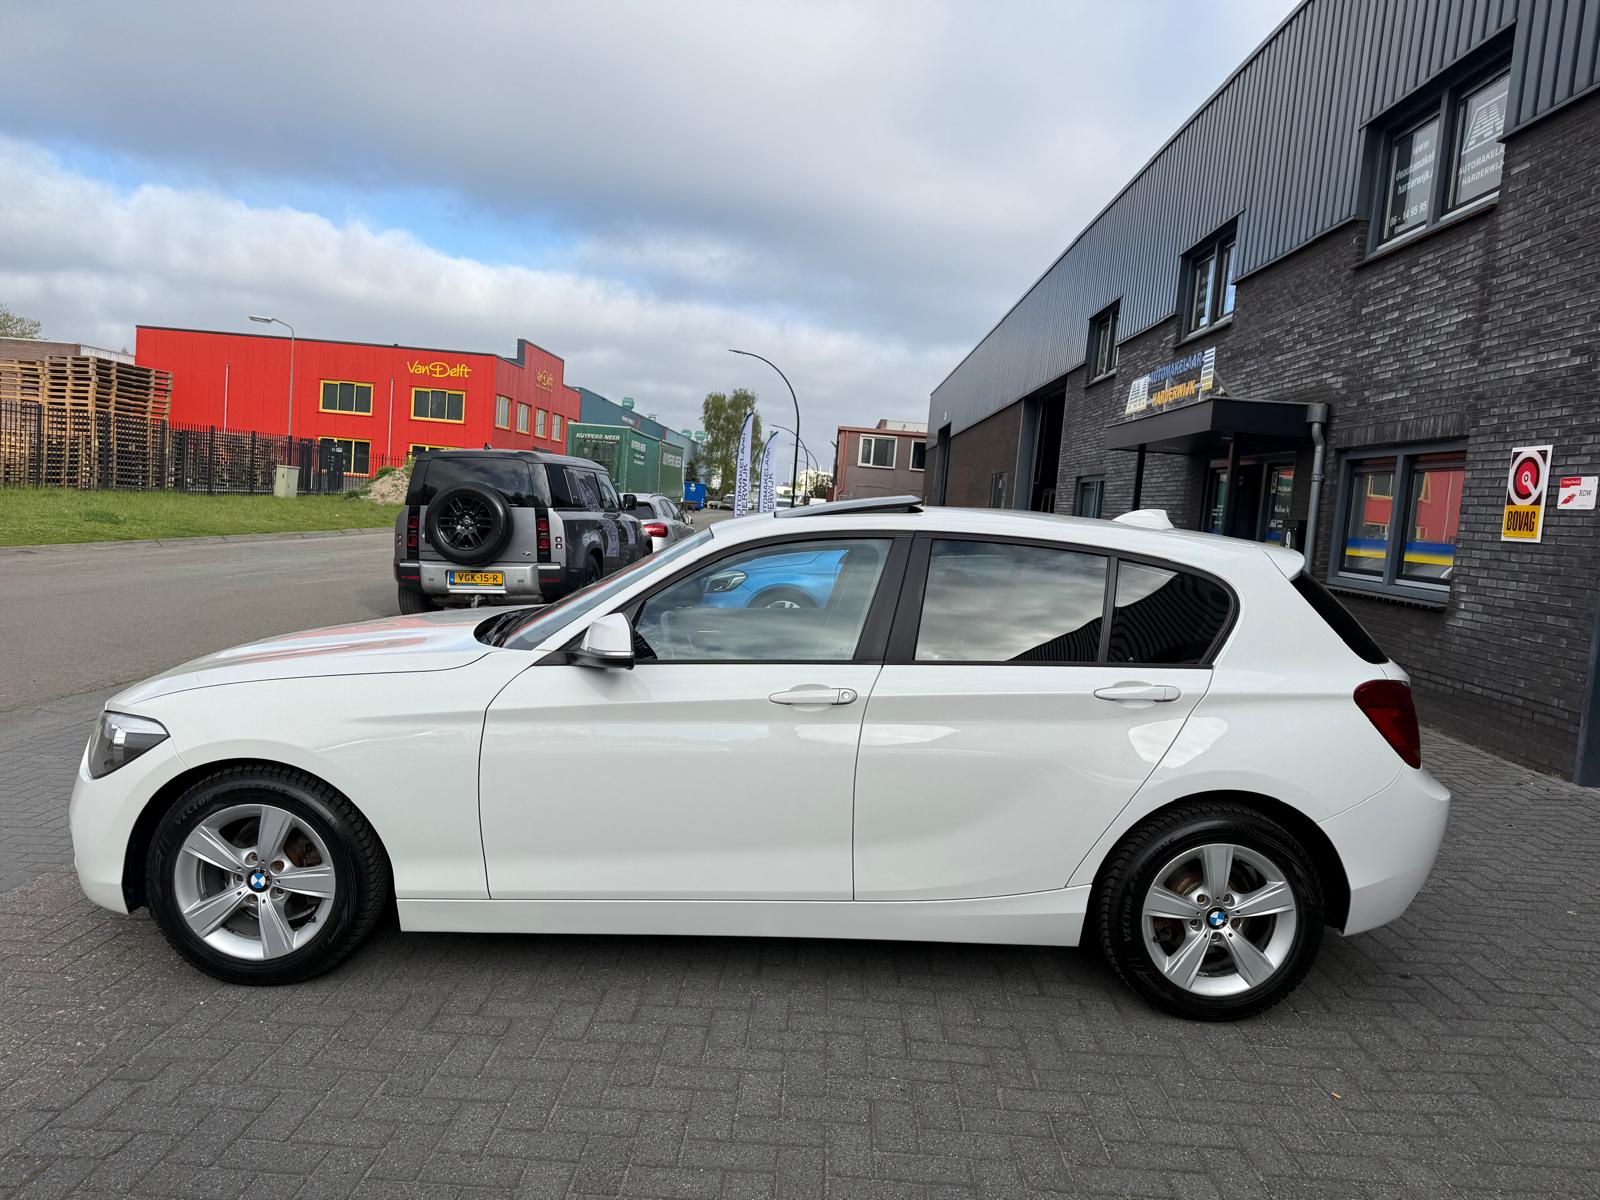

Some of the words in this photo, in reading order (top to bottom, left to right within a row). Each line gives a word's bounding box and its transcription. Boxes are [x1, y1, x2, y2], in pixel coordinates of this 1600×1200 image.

[1150, 352, 1203, 382] AUTOMAKELAAR
[1151, 379, 1196, 407] HARDERWIJK
[1506, 511, 1536, 532] BOVAG
[458, 572, 499, 583] VGK-15-R
